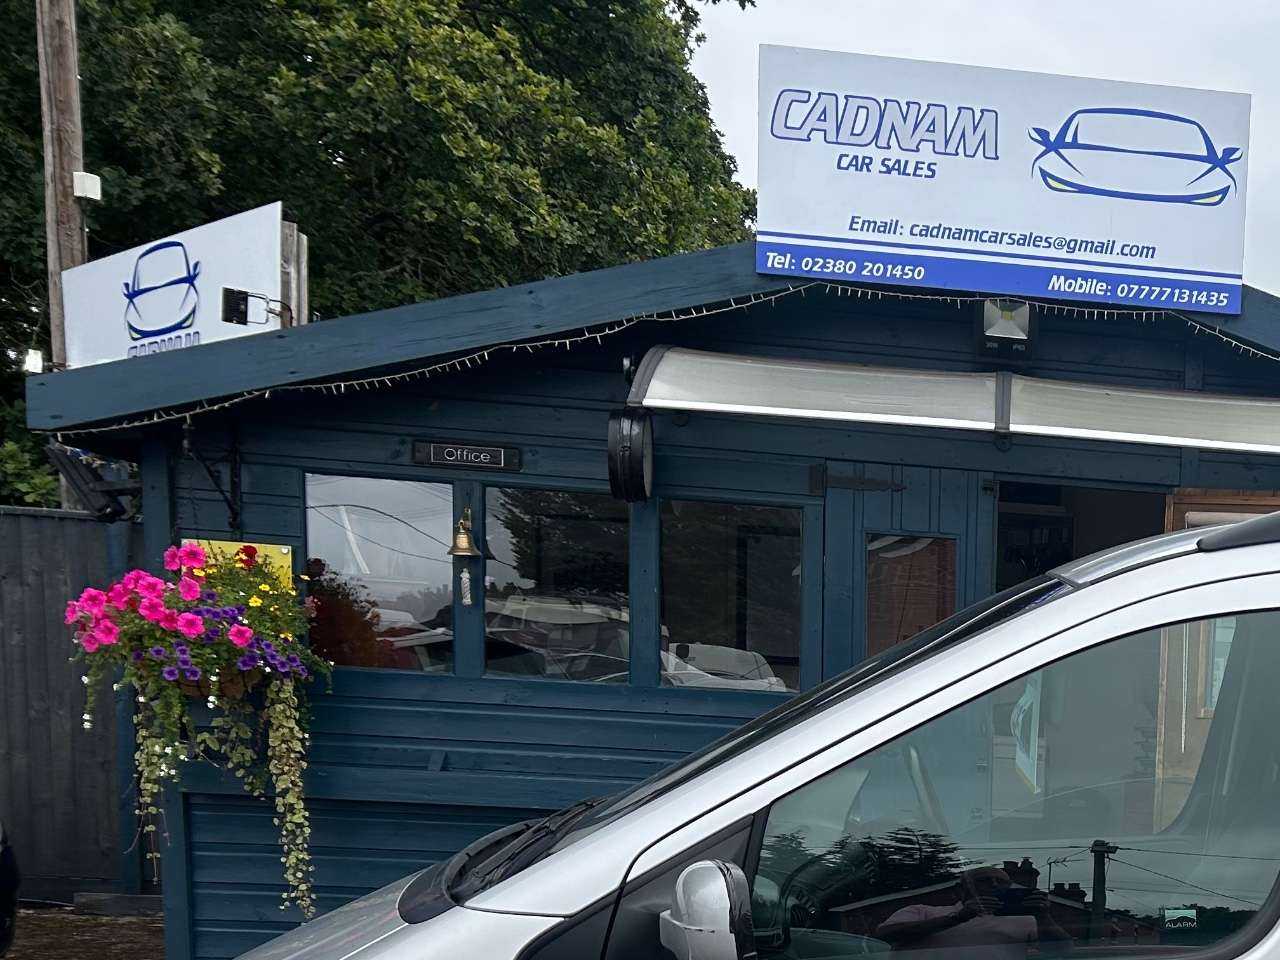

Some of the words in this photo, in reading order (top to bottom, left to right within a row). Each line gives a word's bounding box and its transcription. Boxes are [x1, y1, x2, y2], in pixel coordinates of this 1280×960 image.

[770, 88, 1000, 160] CADNAM
[836, 153, 873, 174] CAR
[879, 157, 937, 179] SALES
[848, 215, 904, 237] Email:
[909, 221, 1157, 260] cadnamcarsales@gmail.com
[765, 252, 796, 271] Tel:
[801, 257, 857, 275] 02380
[861, 262, 926, 280] 201450
[1048, 275, 1112, 296] Mobile:
[1116, 283, 1230, 307] 07777131435
[443, 448, 491, 463] Office
